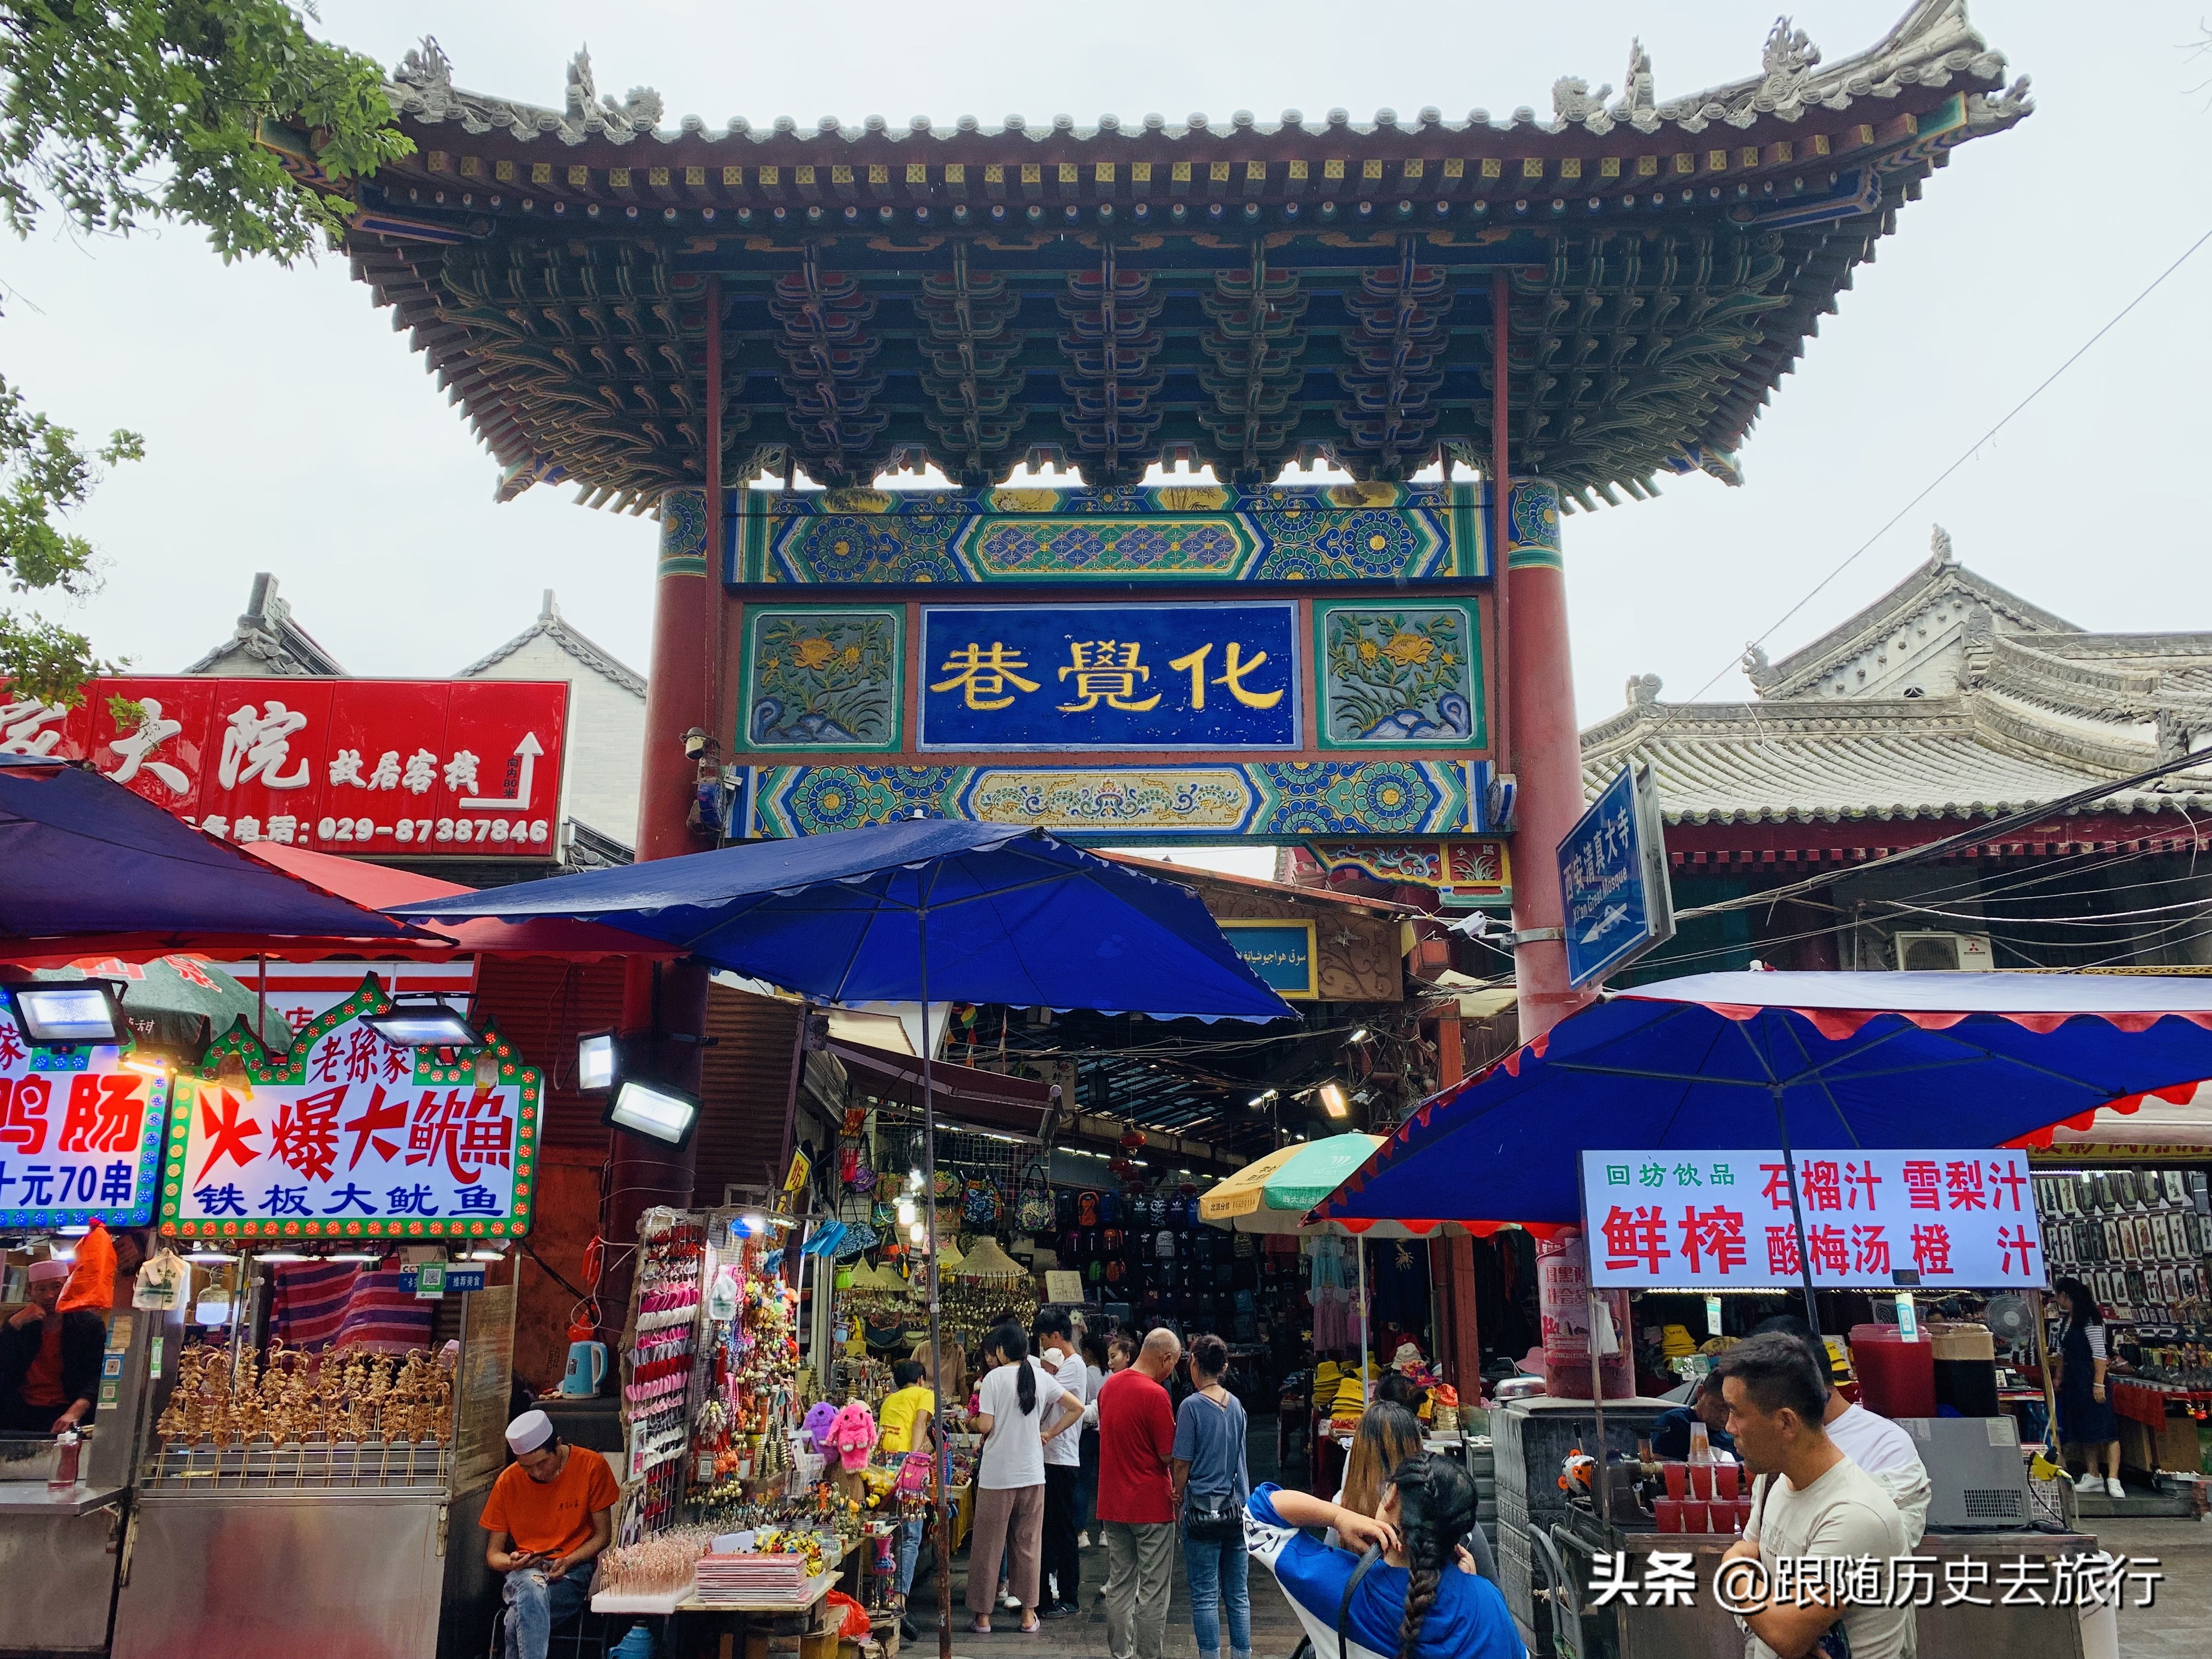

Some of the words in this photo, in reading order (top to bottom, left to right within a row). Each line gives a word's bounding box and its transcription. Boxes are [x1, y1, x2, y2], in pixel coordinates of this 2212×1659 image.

[328, 747, 481, 795] 故居客栈
[1564, 805, 1629, 904] 西安清真大寺
[1587, 888, 1602, 911] Great
[1602, 866, 1627, 900] Mosque
[193, 1182, 504, 1216] 铁板大鱿鱼
[1606, 1163, 1734, 1188] 回坊饮品
[1759, 1159, 1882, 1211] 石榴汁
[1903, 1160, 2027, 1212] 雪梨汁
[1601, 1205, 1746, 1274] 鲜榨
[1765, 1223, 1891, 1276] 酸梅汤
[453, 1276, 480, 1287] 推荐美食
